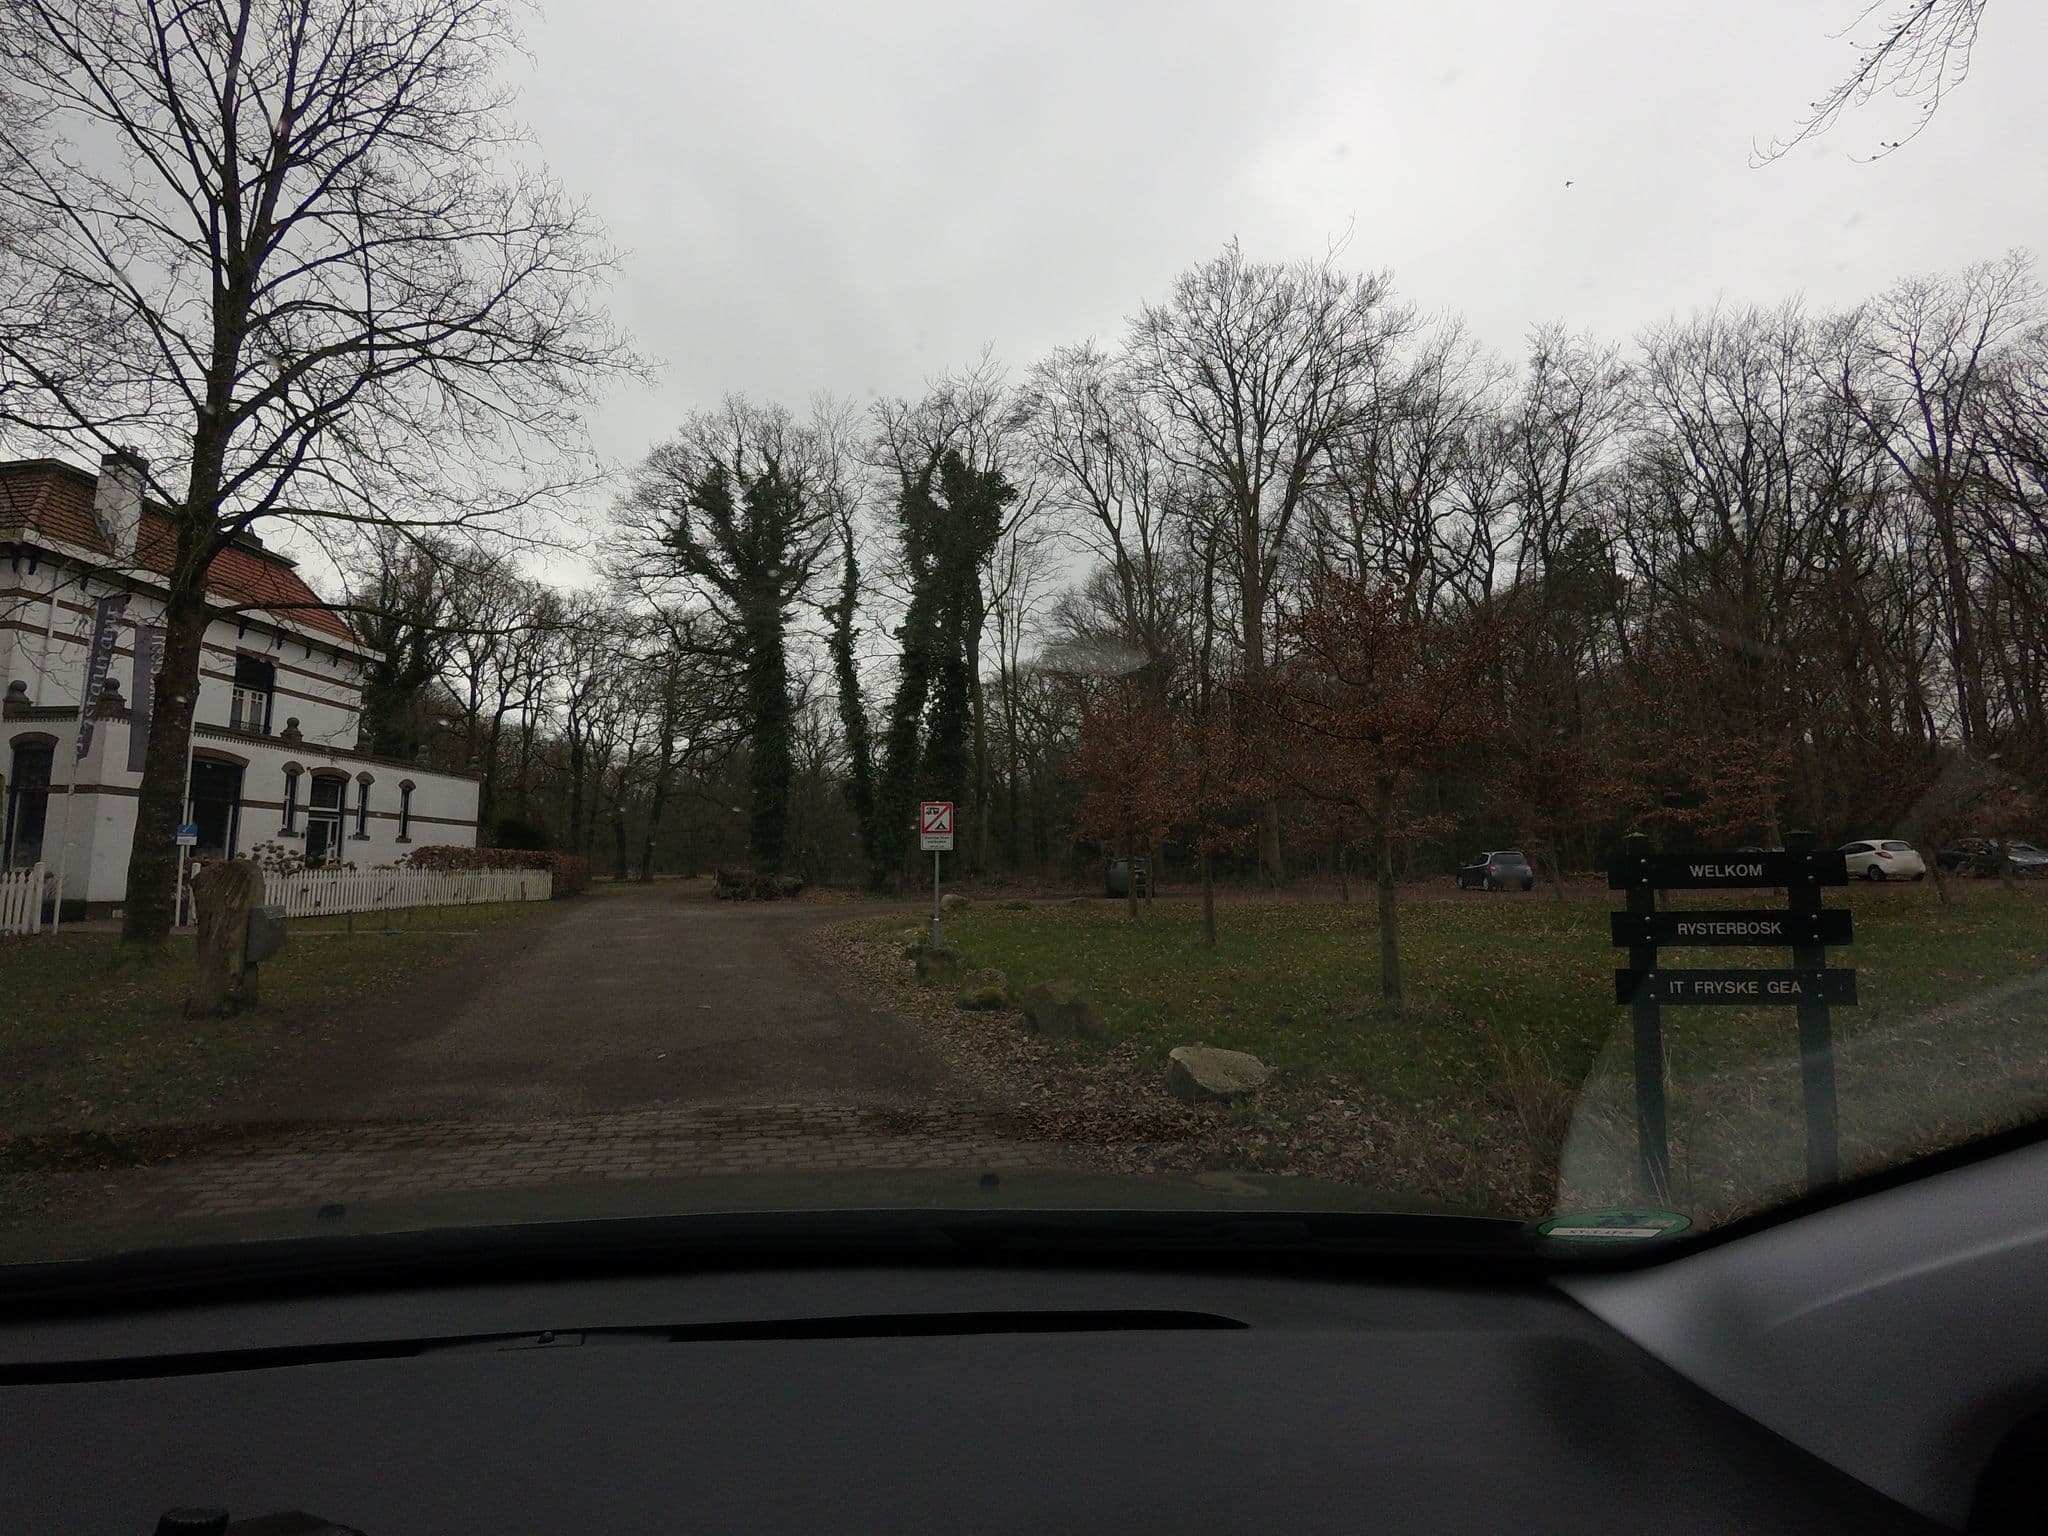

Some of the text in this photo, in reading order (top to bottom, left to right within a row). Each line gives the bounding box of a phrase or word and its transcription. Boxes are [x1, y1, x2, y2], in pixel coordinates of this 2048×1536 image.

[1689, 864, 1763, 878] WELKOM
[1677, 921, 1783, 936] RYSTERBOSK
[1669, 980, 1803, 995] IT FRYSKE GEA
